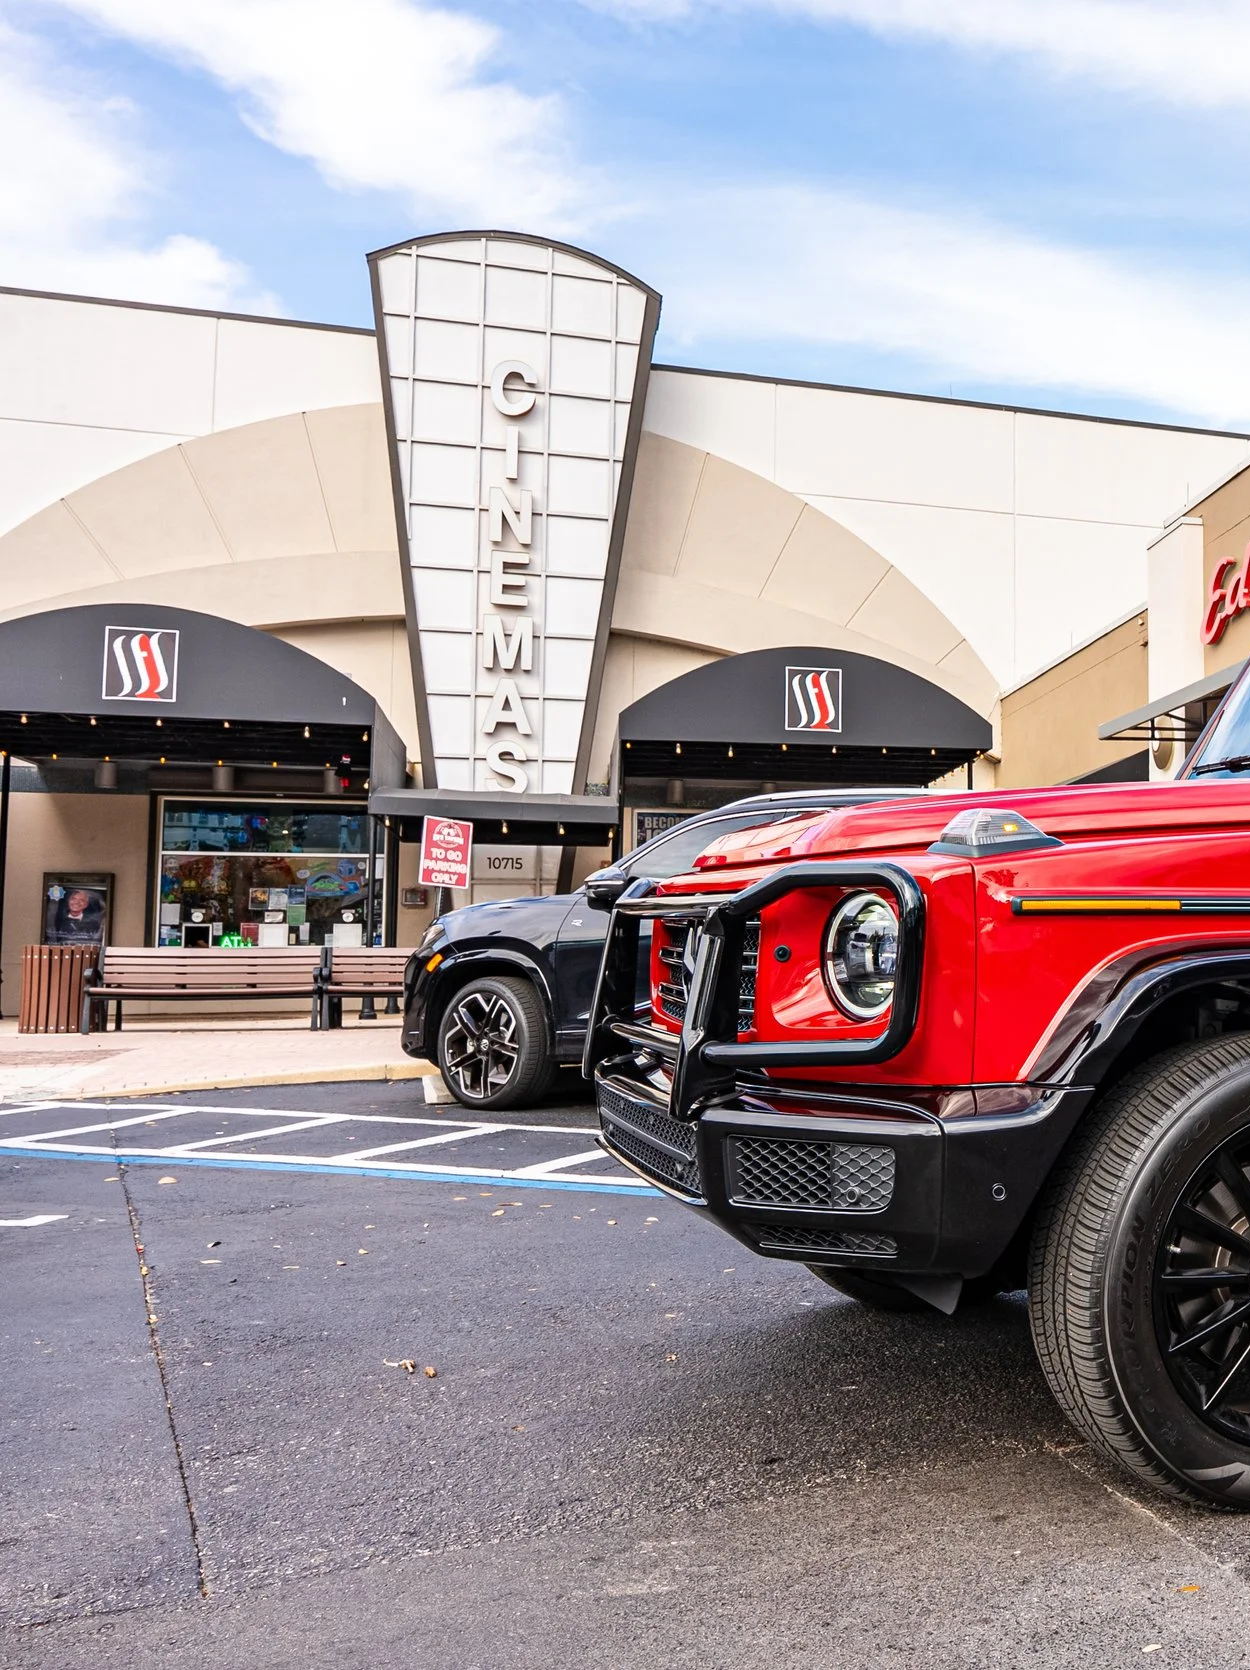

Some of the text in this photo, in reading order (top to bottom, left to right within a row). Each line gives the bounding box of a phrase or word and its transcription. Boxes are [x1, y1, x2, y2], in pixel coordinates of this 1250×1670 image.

[481, 359, 538, 794] CINEMAS
[430, 847, 463, 862] TO GO
[423, 859, 467, 874] PARKING
[487, 856, 523, 870] 10715
[431, 872, 458, 885] ONLY
